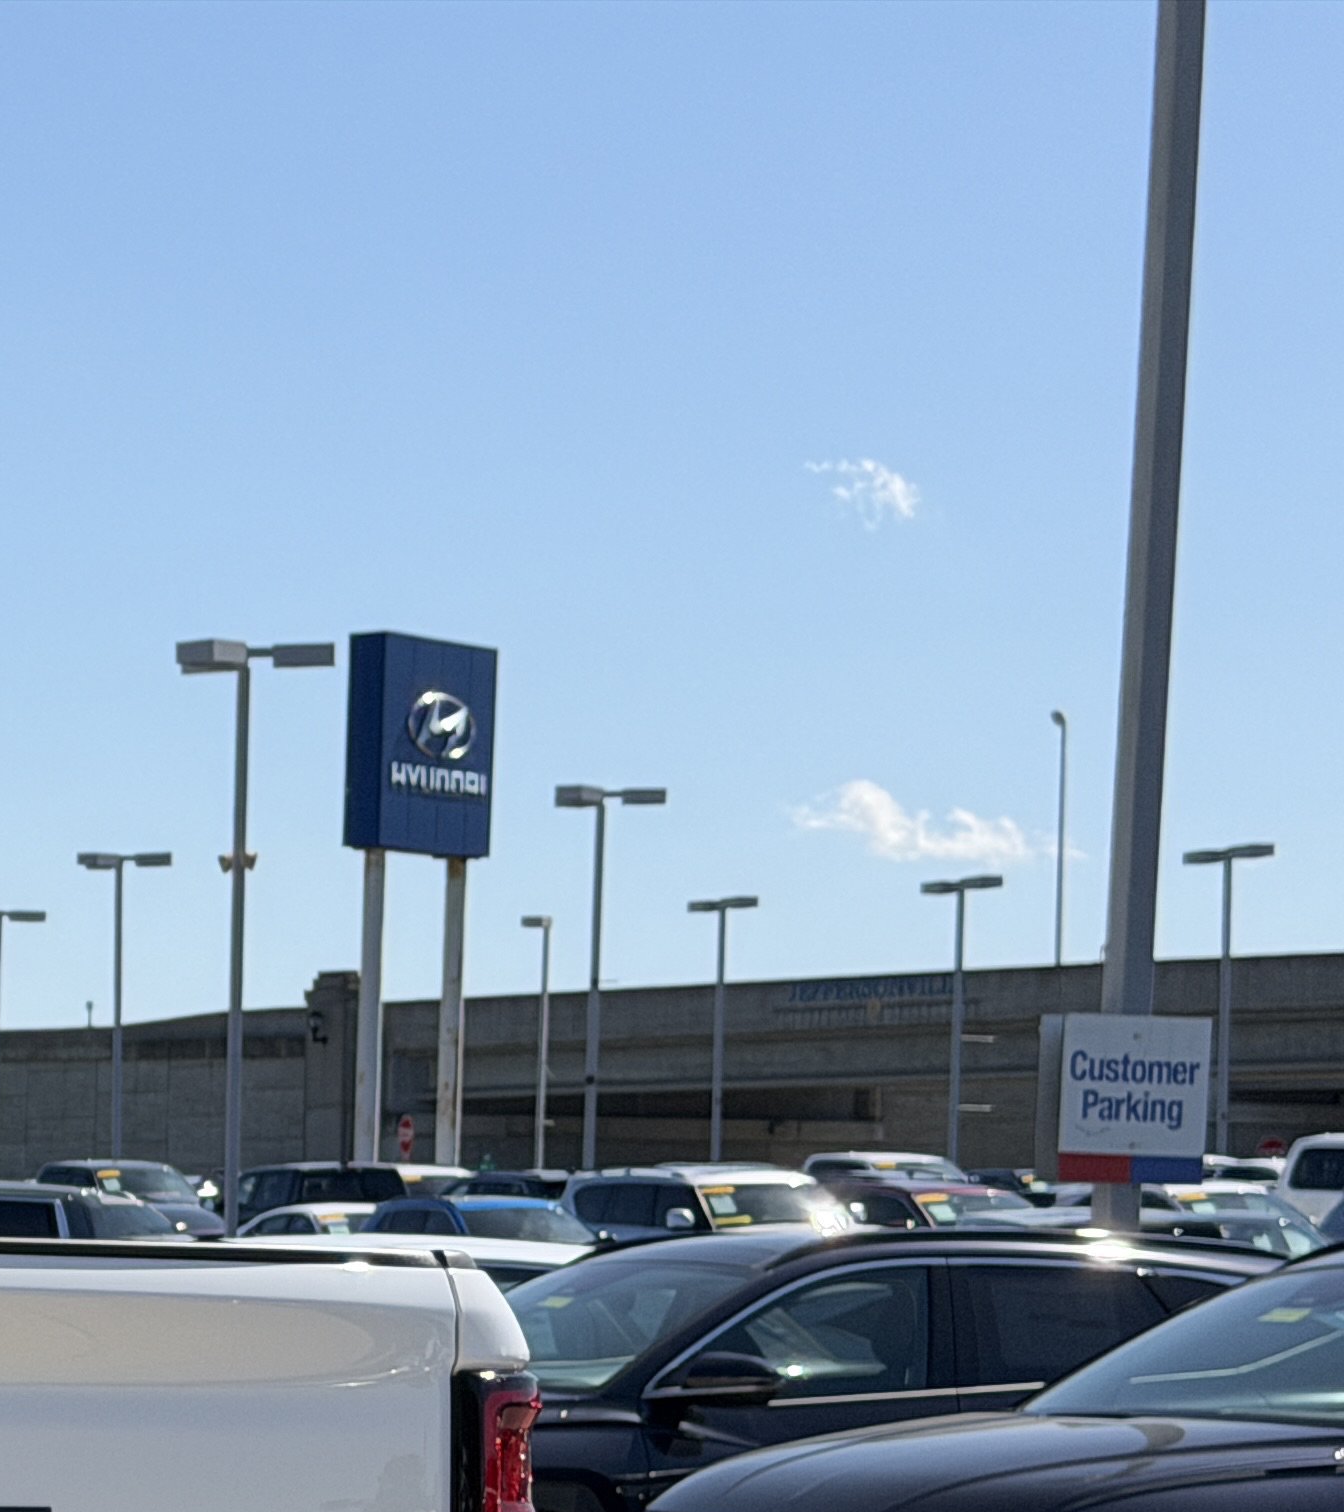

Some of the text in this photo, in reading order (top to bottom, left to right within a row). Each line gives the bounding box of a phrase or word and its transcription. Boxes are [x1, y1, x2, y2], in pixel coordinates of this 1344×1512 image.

[391, 760, 488, 796] HYUNDAI
[1070, 1049, 1201, 1087] Customer
[1081, 1088, 1184, 1131] Parking
